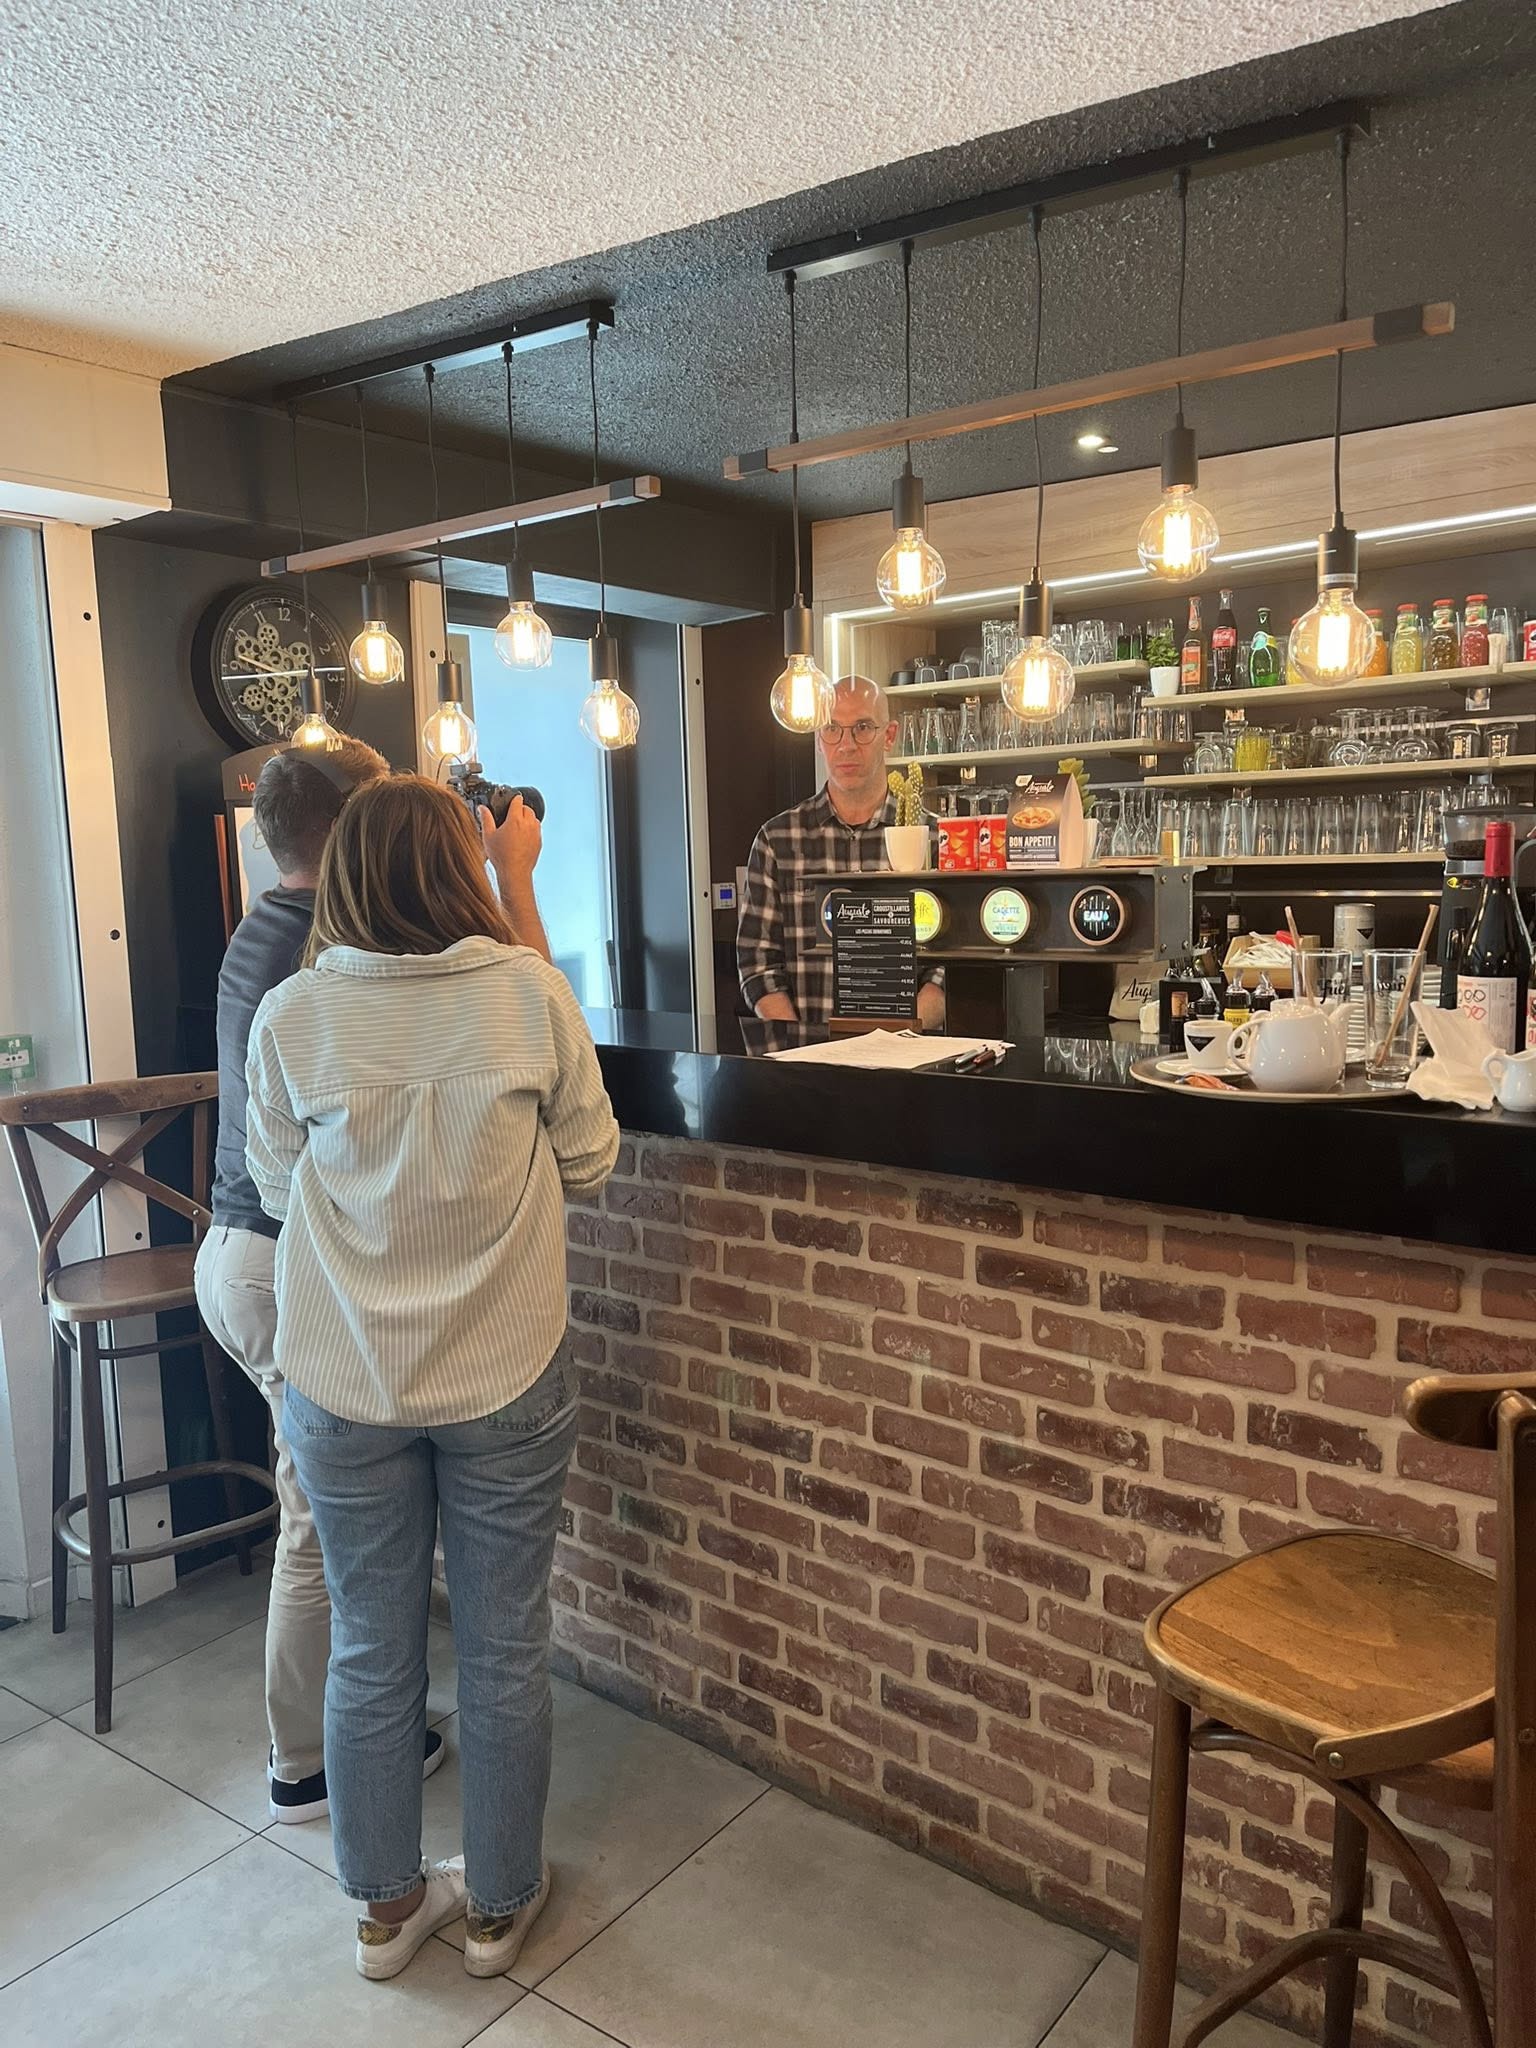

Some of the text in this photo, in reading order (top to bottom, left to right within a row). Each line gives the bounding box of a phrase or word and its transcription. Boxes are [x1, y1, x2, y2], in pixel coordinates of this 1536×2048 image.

[278, 607, 291, 621] 12
[318, 643, 331, 656] 2
[327, 672, 339, 683] 3
[238, 773, 256, 792] Ho
[1009, 836, 1023, 848] BON
[1024, 835, 1052, 848] APPETIT
[1083, 910, 1104, 921] EAU
[1121, 977, 1152, 1004] Aug
